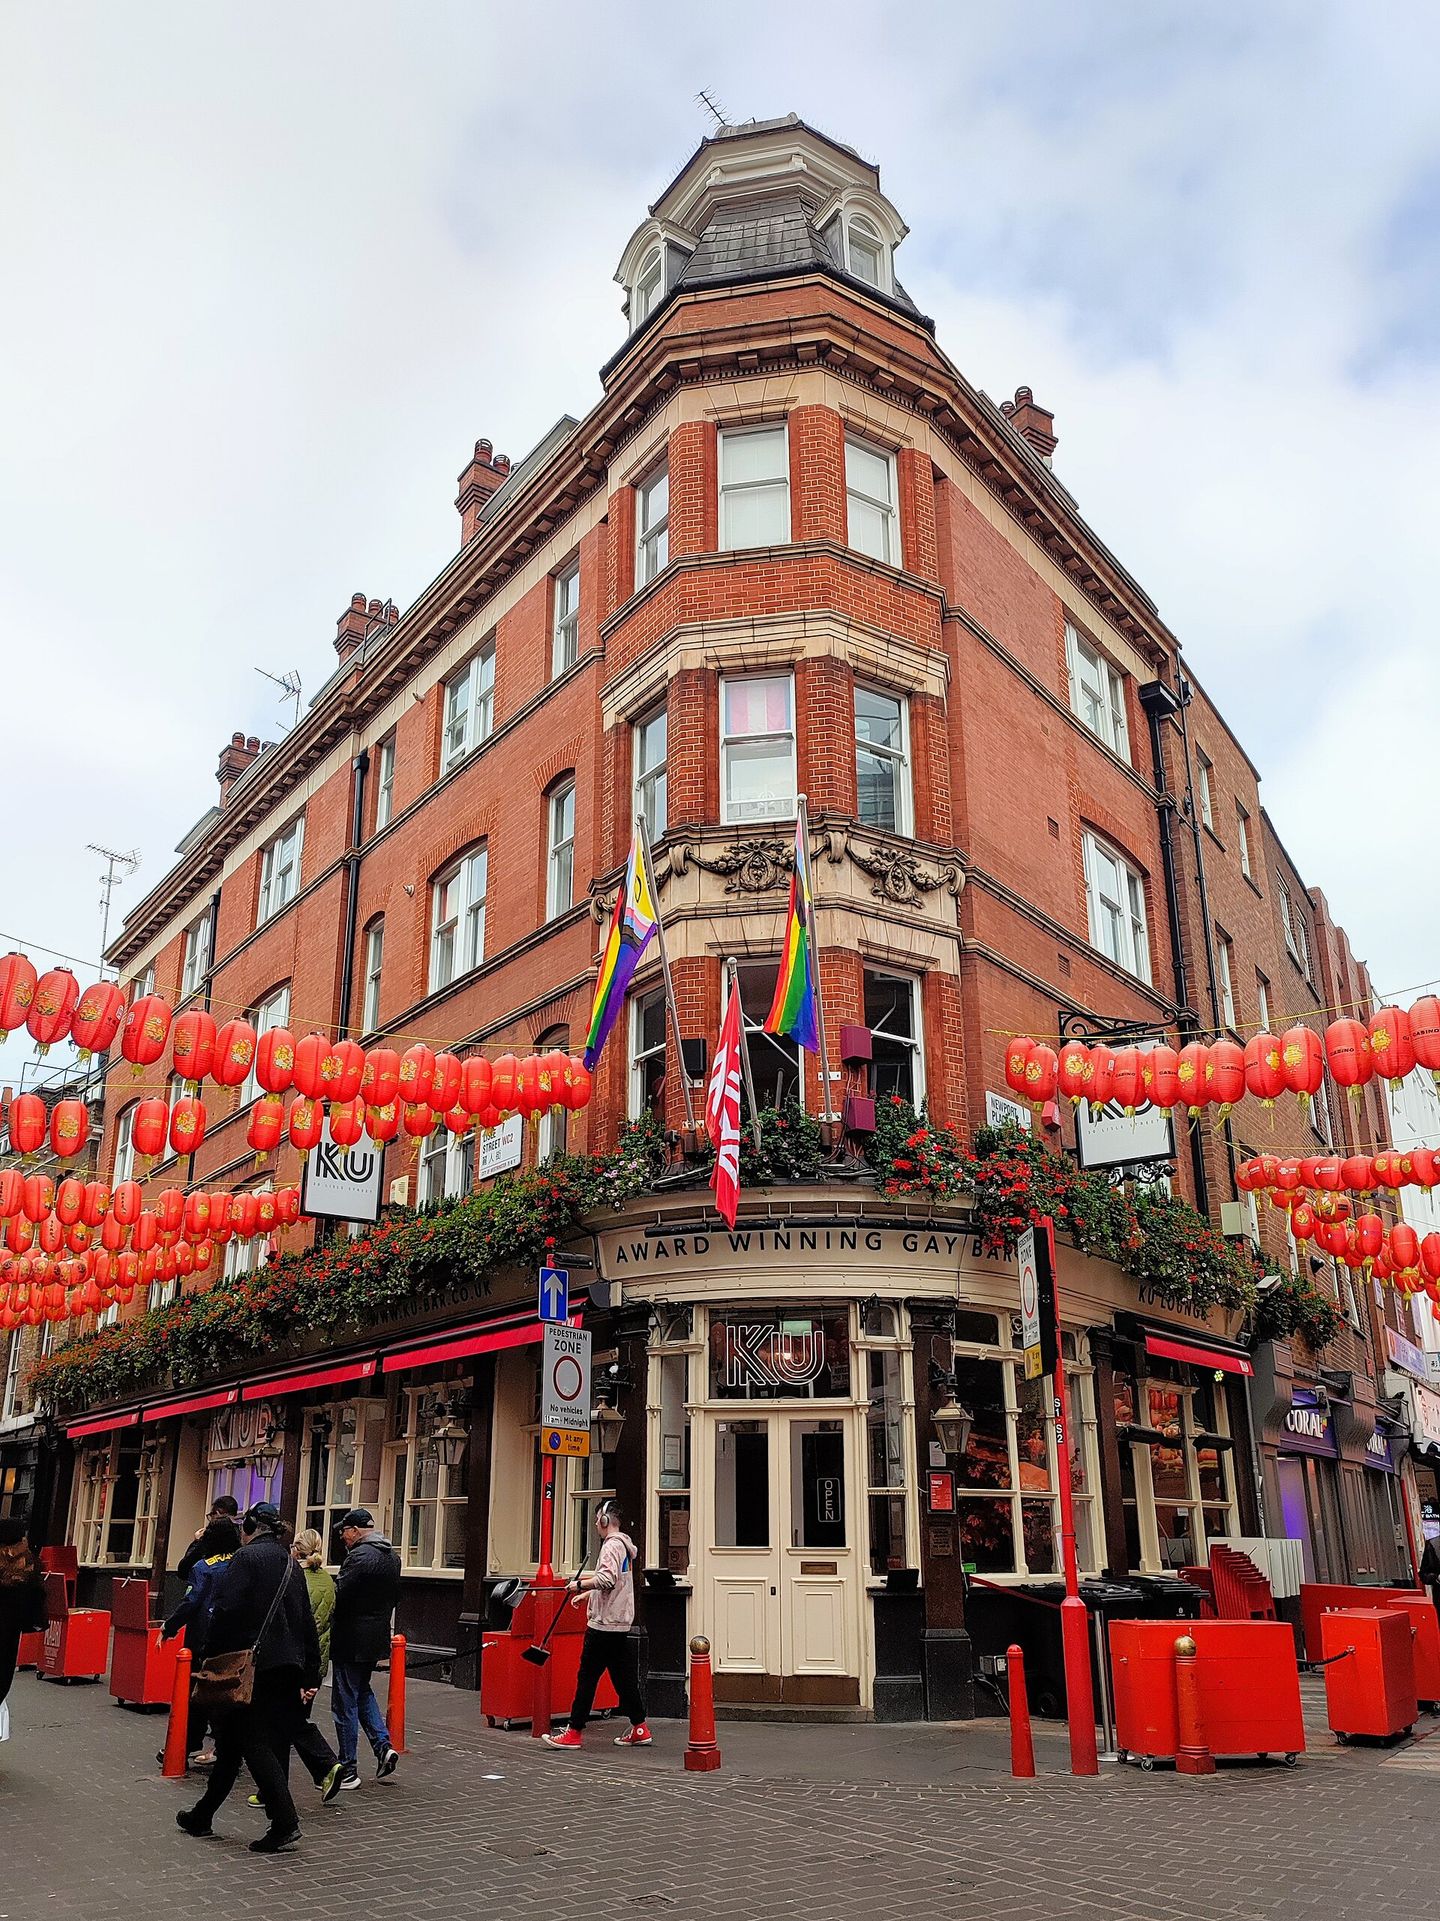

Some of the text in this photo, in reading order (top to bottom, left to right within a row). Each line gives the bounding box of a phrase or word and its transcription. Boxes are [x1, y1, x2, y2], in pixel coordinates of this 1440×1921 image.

[990, 1096, 1017, 1118] NEWPORT
[482, 1132, 514, 1155] STREET WC2
[315, 1141, 375, 1184] KU
[616, 1230, 1018, 1265] AWARD WINNING GAY BAR
[1138, 1285, 1155, 1306] KU
[549, 1327, 588, 1341] PEDESTRIAN
[554, 1339, 582, 1355] ZONE
[726, 1324, 825, 1387] KU
[550, 1403, 583, 1415] No vehicles
[1286, 1409, 1324, 1439] CORAL
[824, 1480, 834, 1520] OPEN
